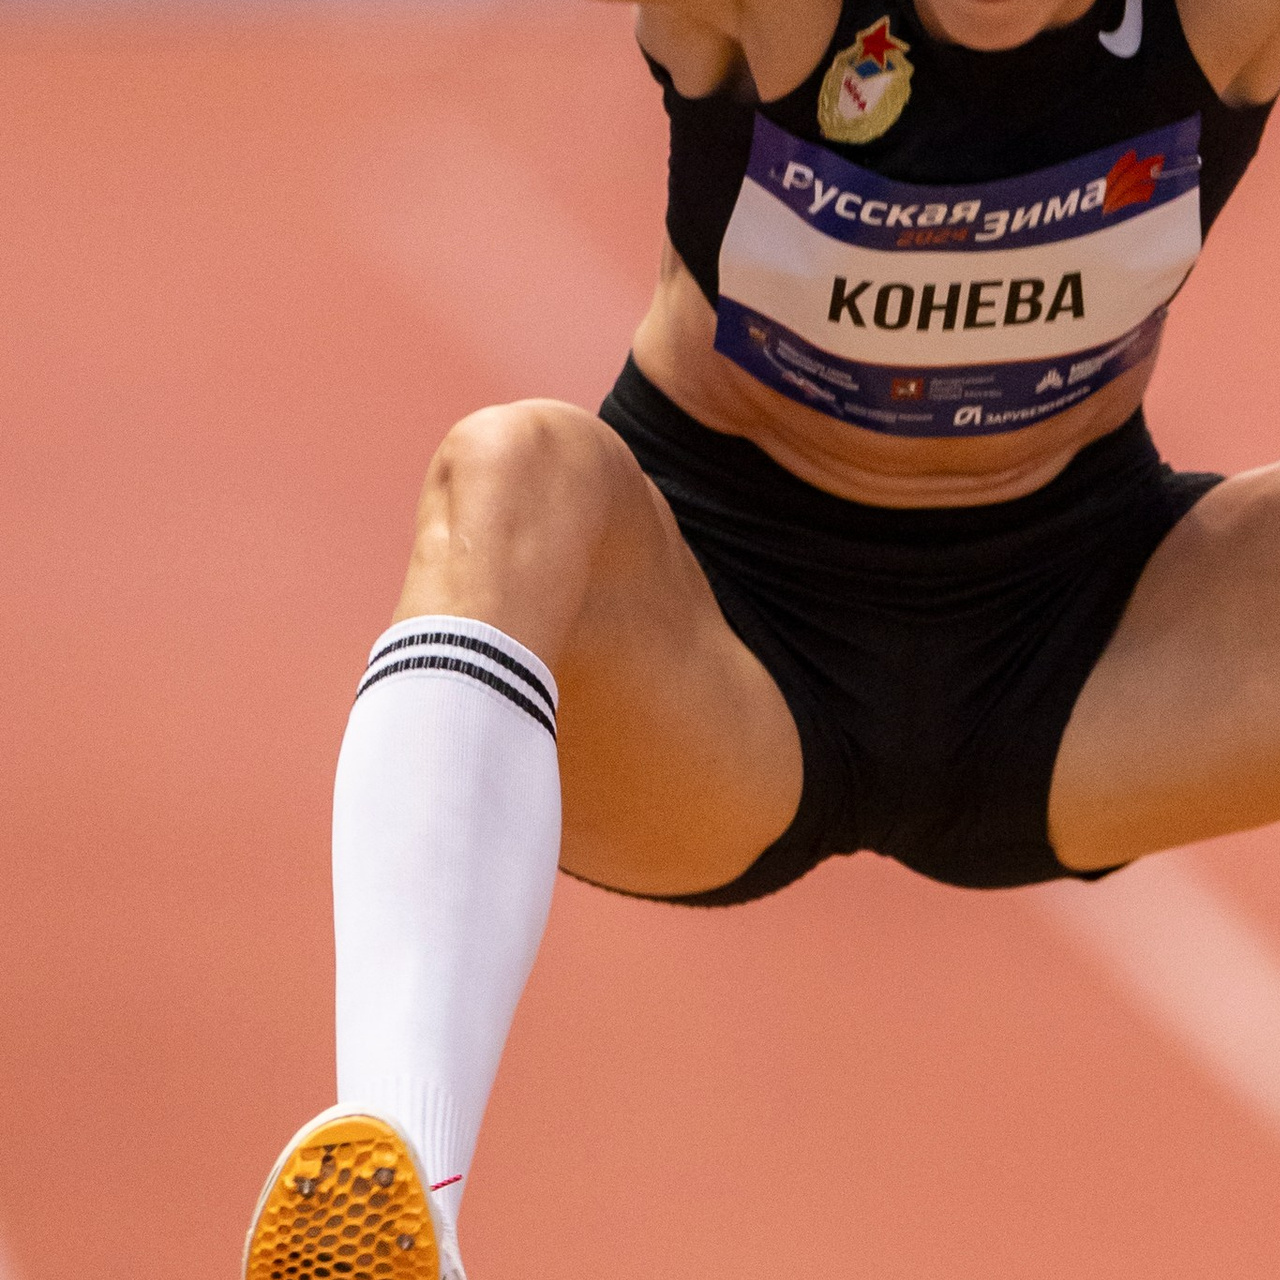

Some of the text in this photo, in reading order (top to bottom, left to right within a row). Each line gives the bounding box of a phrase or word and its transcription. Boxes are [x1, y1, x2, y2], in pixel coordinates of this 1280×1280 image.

[782, 160, 1107, 242] Русская зима
[828, 272, 1086, 332] КОНЕВА
